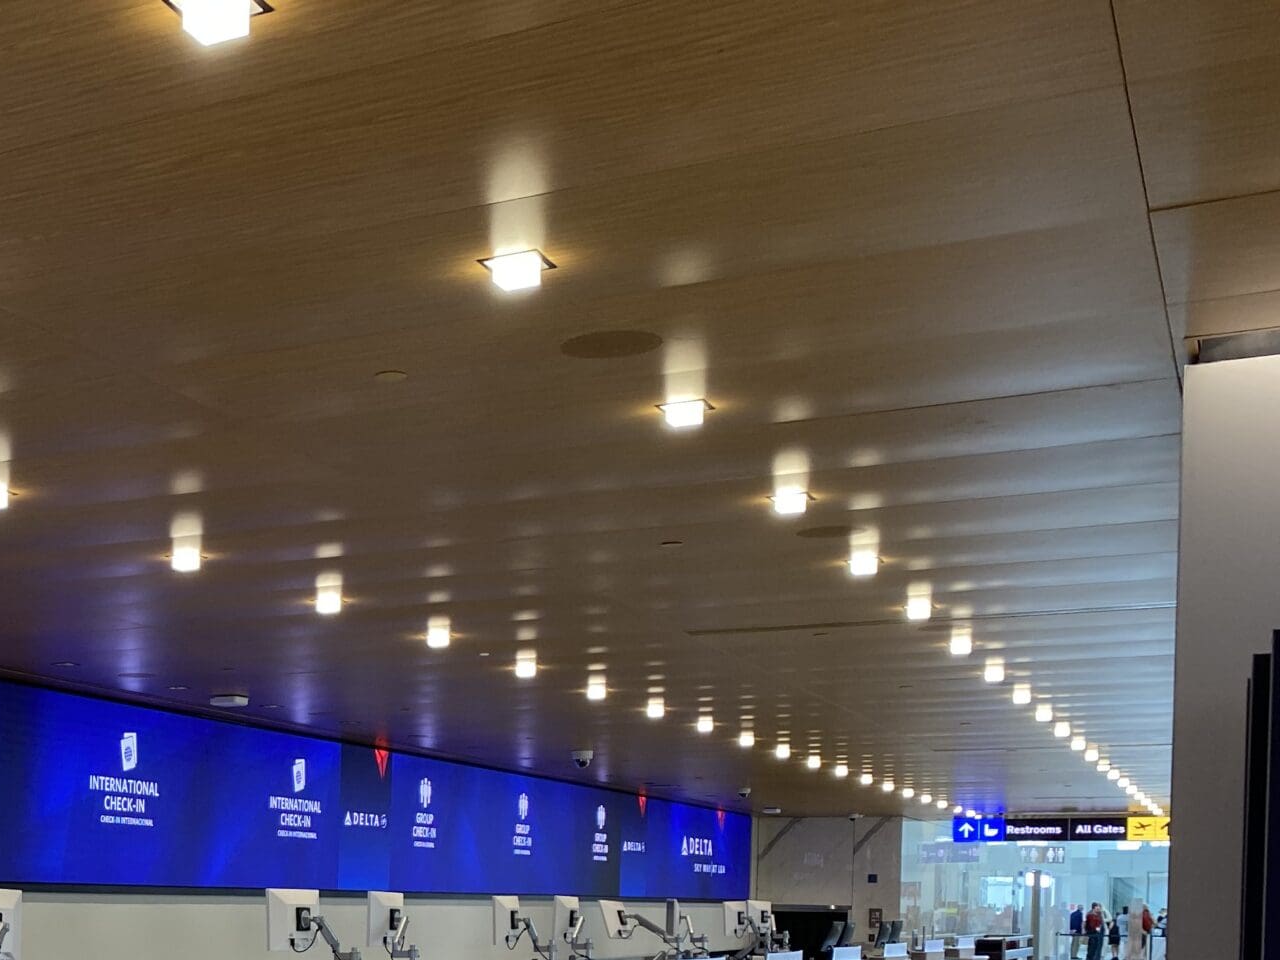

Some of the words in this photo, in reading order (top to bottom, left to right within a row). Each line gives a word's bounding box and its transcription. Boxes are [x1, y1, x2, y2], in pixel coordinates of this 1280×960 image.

[89, 774, 160, 797] INTERNATIONAL
[104, 795, 145, 813] CHECK-IN
[269, 796, 322, 814] INTERNATIONAL
[280, 813, 311, 828] CHECK-IN
[352, 812, 380, 827] DELTA
[1005, 824, 1062, 835] Restrooms
[1075, 824, 1092, 834] All
[1092, 824, 1126, 834] Gates
[689, 836, 713, 856] DELTA
